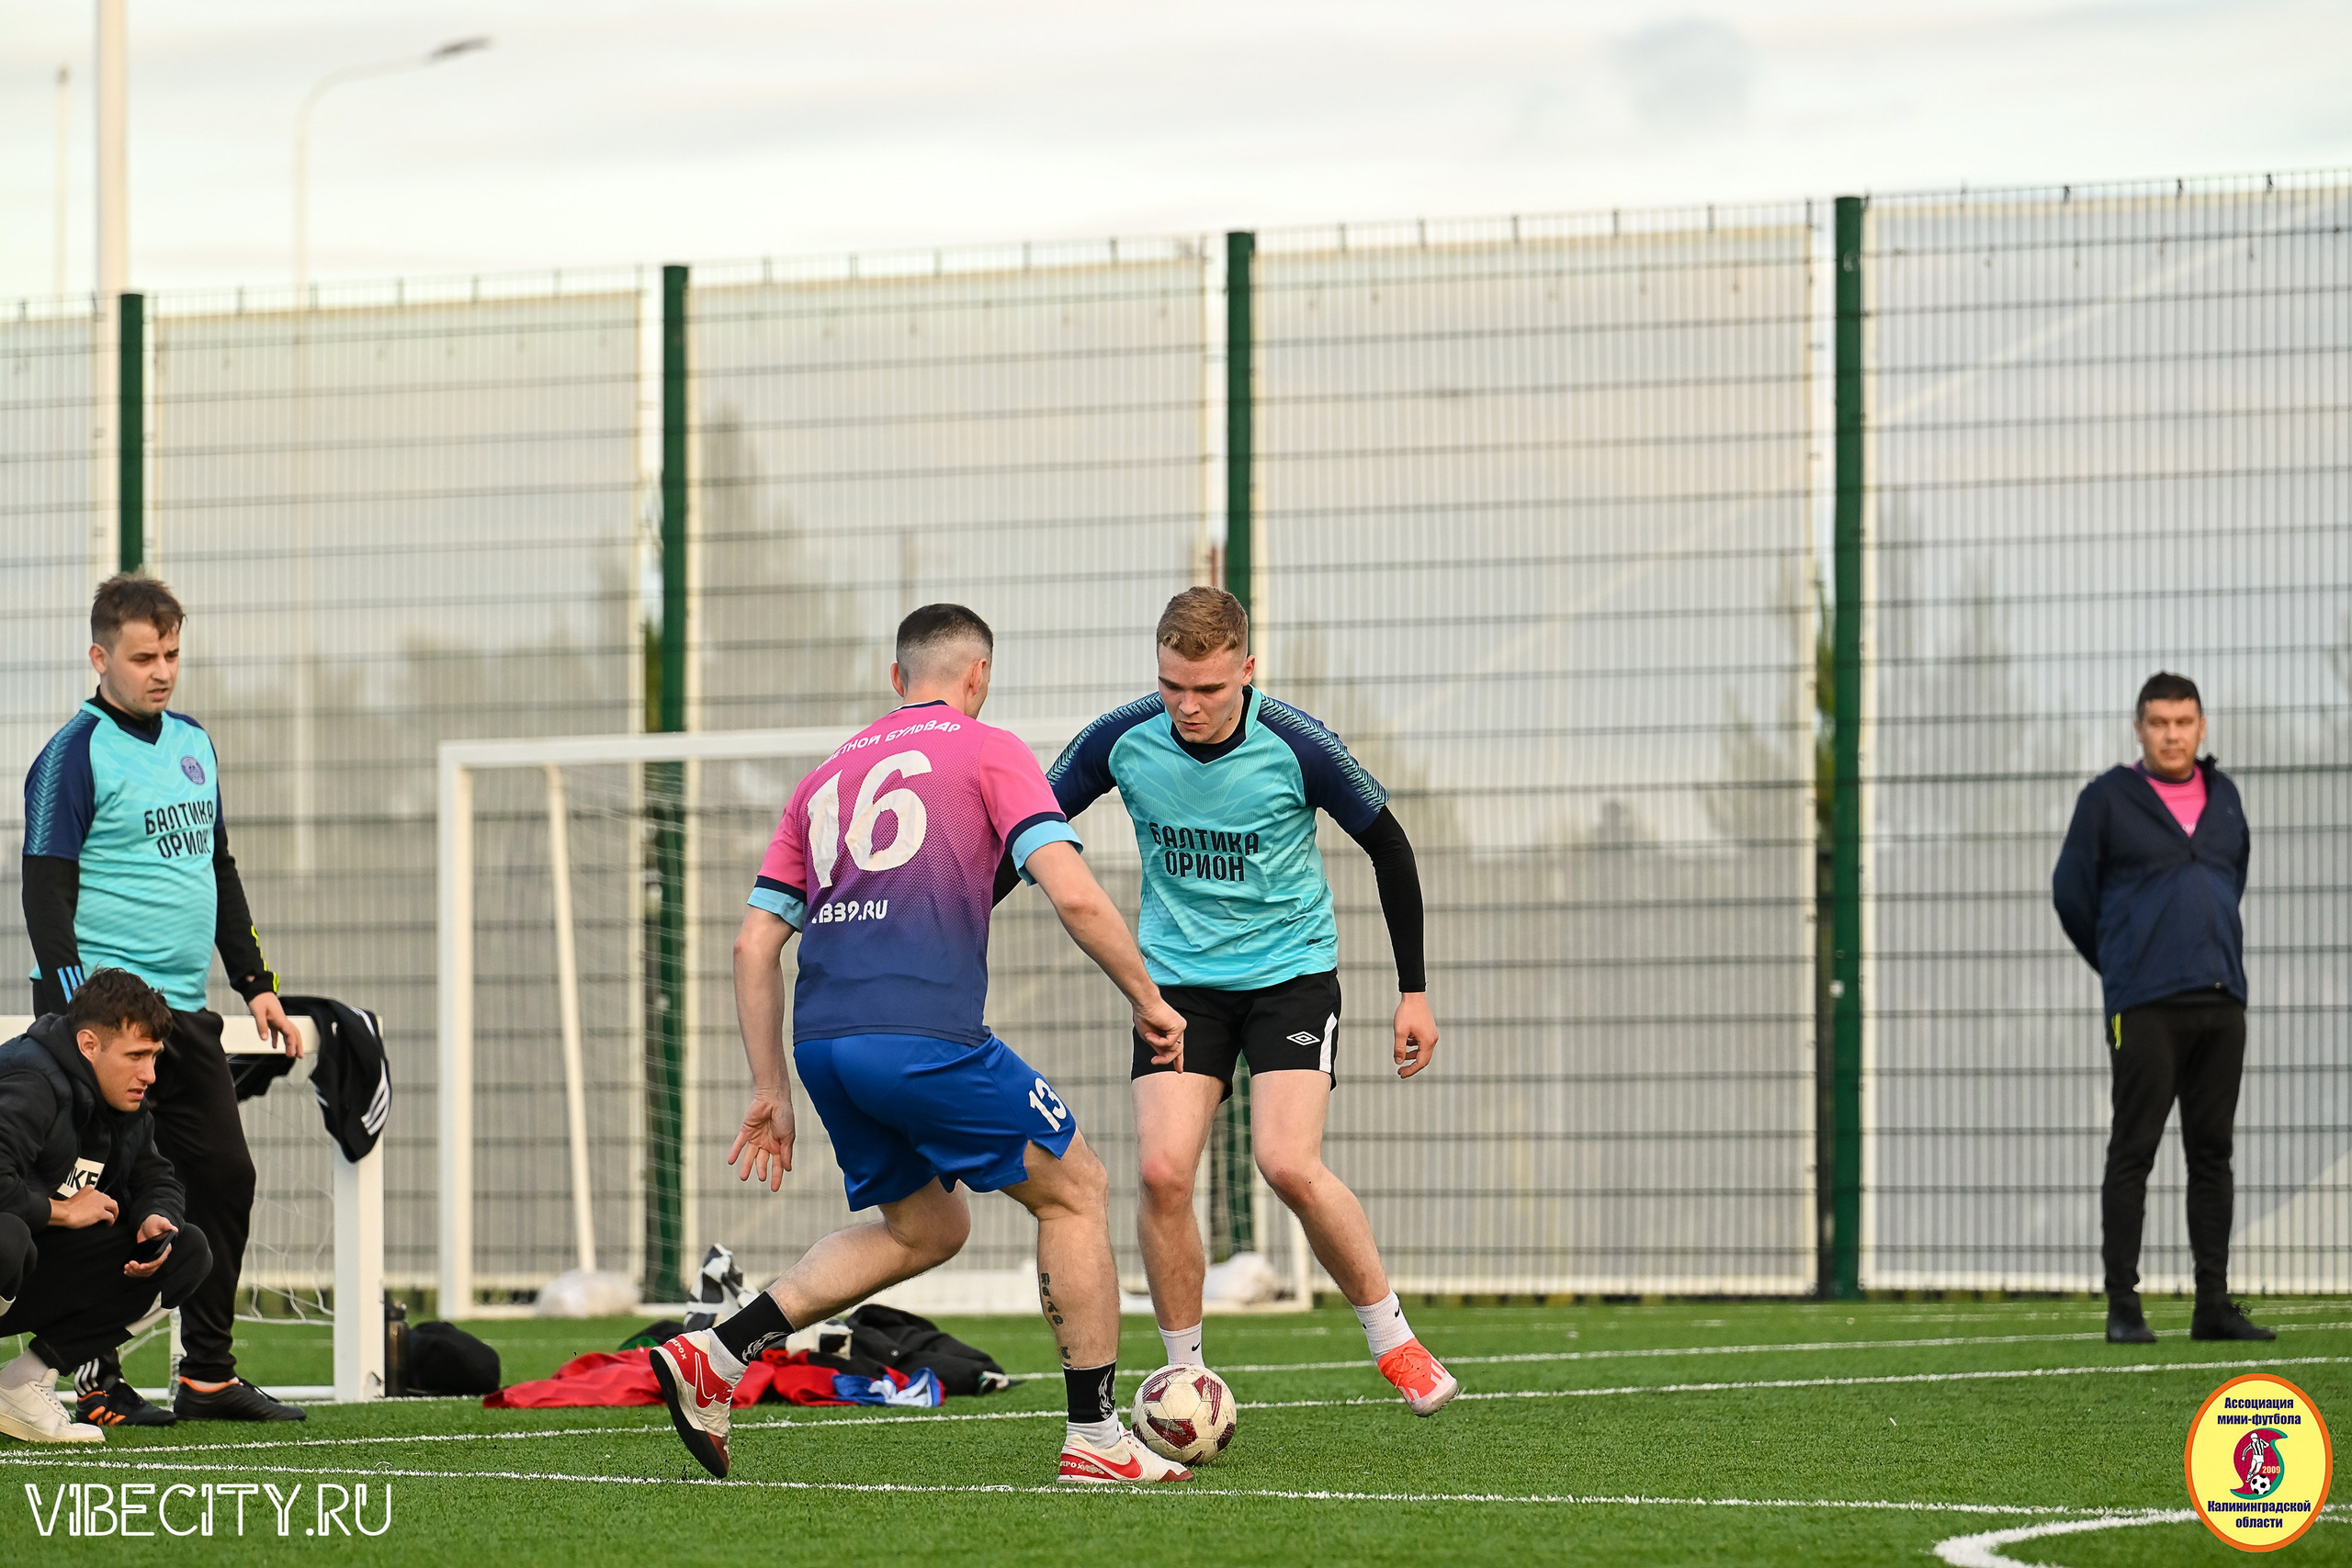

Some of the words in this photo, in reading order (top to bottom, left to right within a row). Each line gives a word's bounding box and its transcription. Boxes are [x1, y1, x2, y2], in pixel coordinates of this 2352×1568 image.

[816, 734, 882, 772] ЕТНОЙ
[885, 719, 962, 742] БУЛЬВАР
[144, 800, 214, 835] БАЛТИКА
[807, 750, 933, 888] 16
[1148, 822, 1259, 856] БАЛТИКА
[1165, 851, 1245, 882] ОРИОН
[811, 900, 888, 924] B39.RU
[1029, 1077, 1067, 1132] 13
